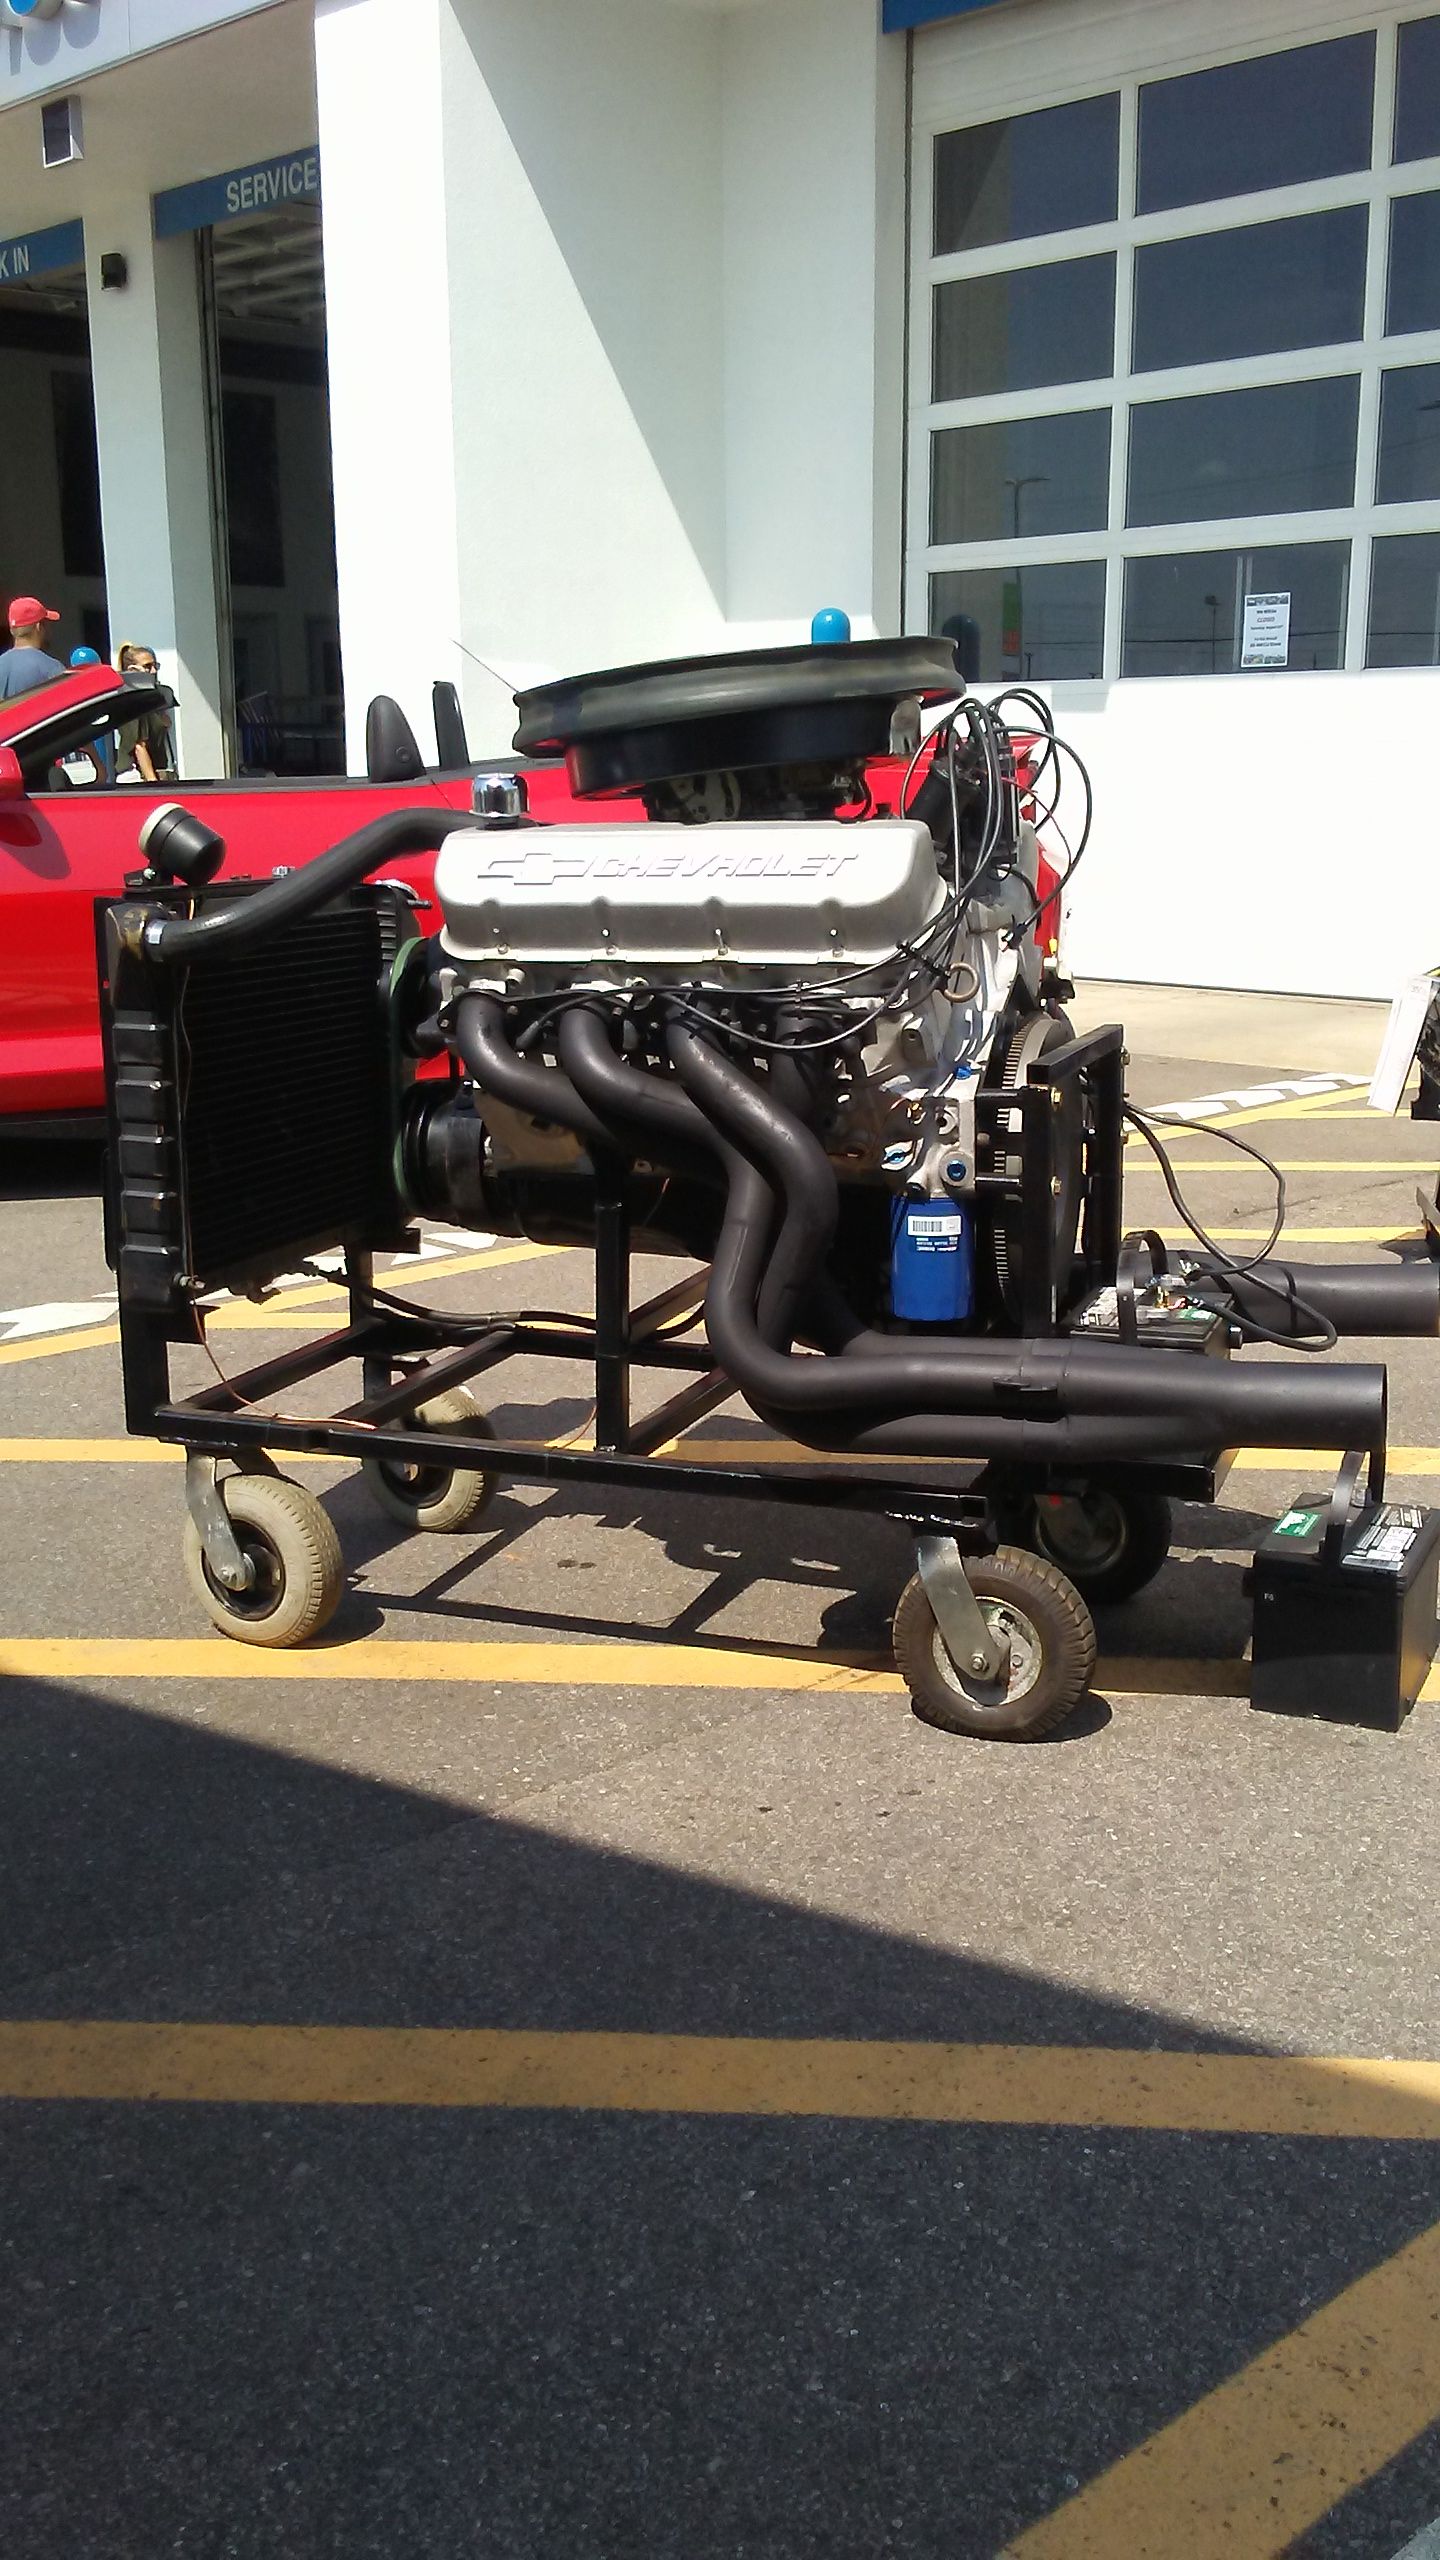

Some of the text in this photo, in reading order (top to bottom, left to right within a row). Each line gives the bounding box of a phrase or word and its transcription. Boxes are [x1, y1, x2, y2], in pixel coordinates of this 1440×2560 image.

[226, 158, 317, 213] SERVICE
[13, 245, 30, 275] IN
[592, 854, 859, 878] CHEVROLET
